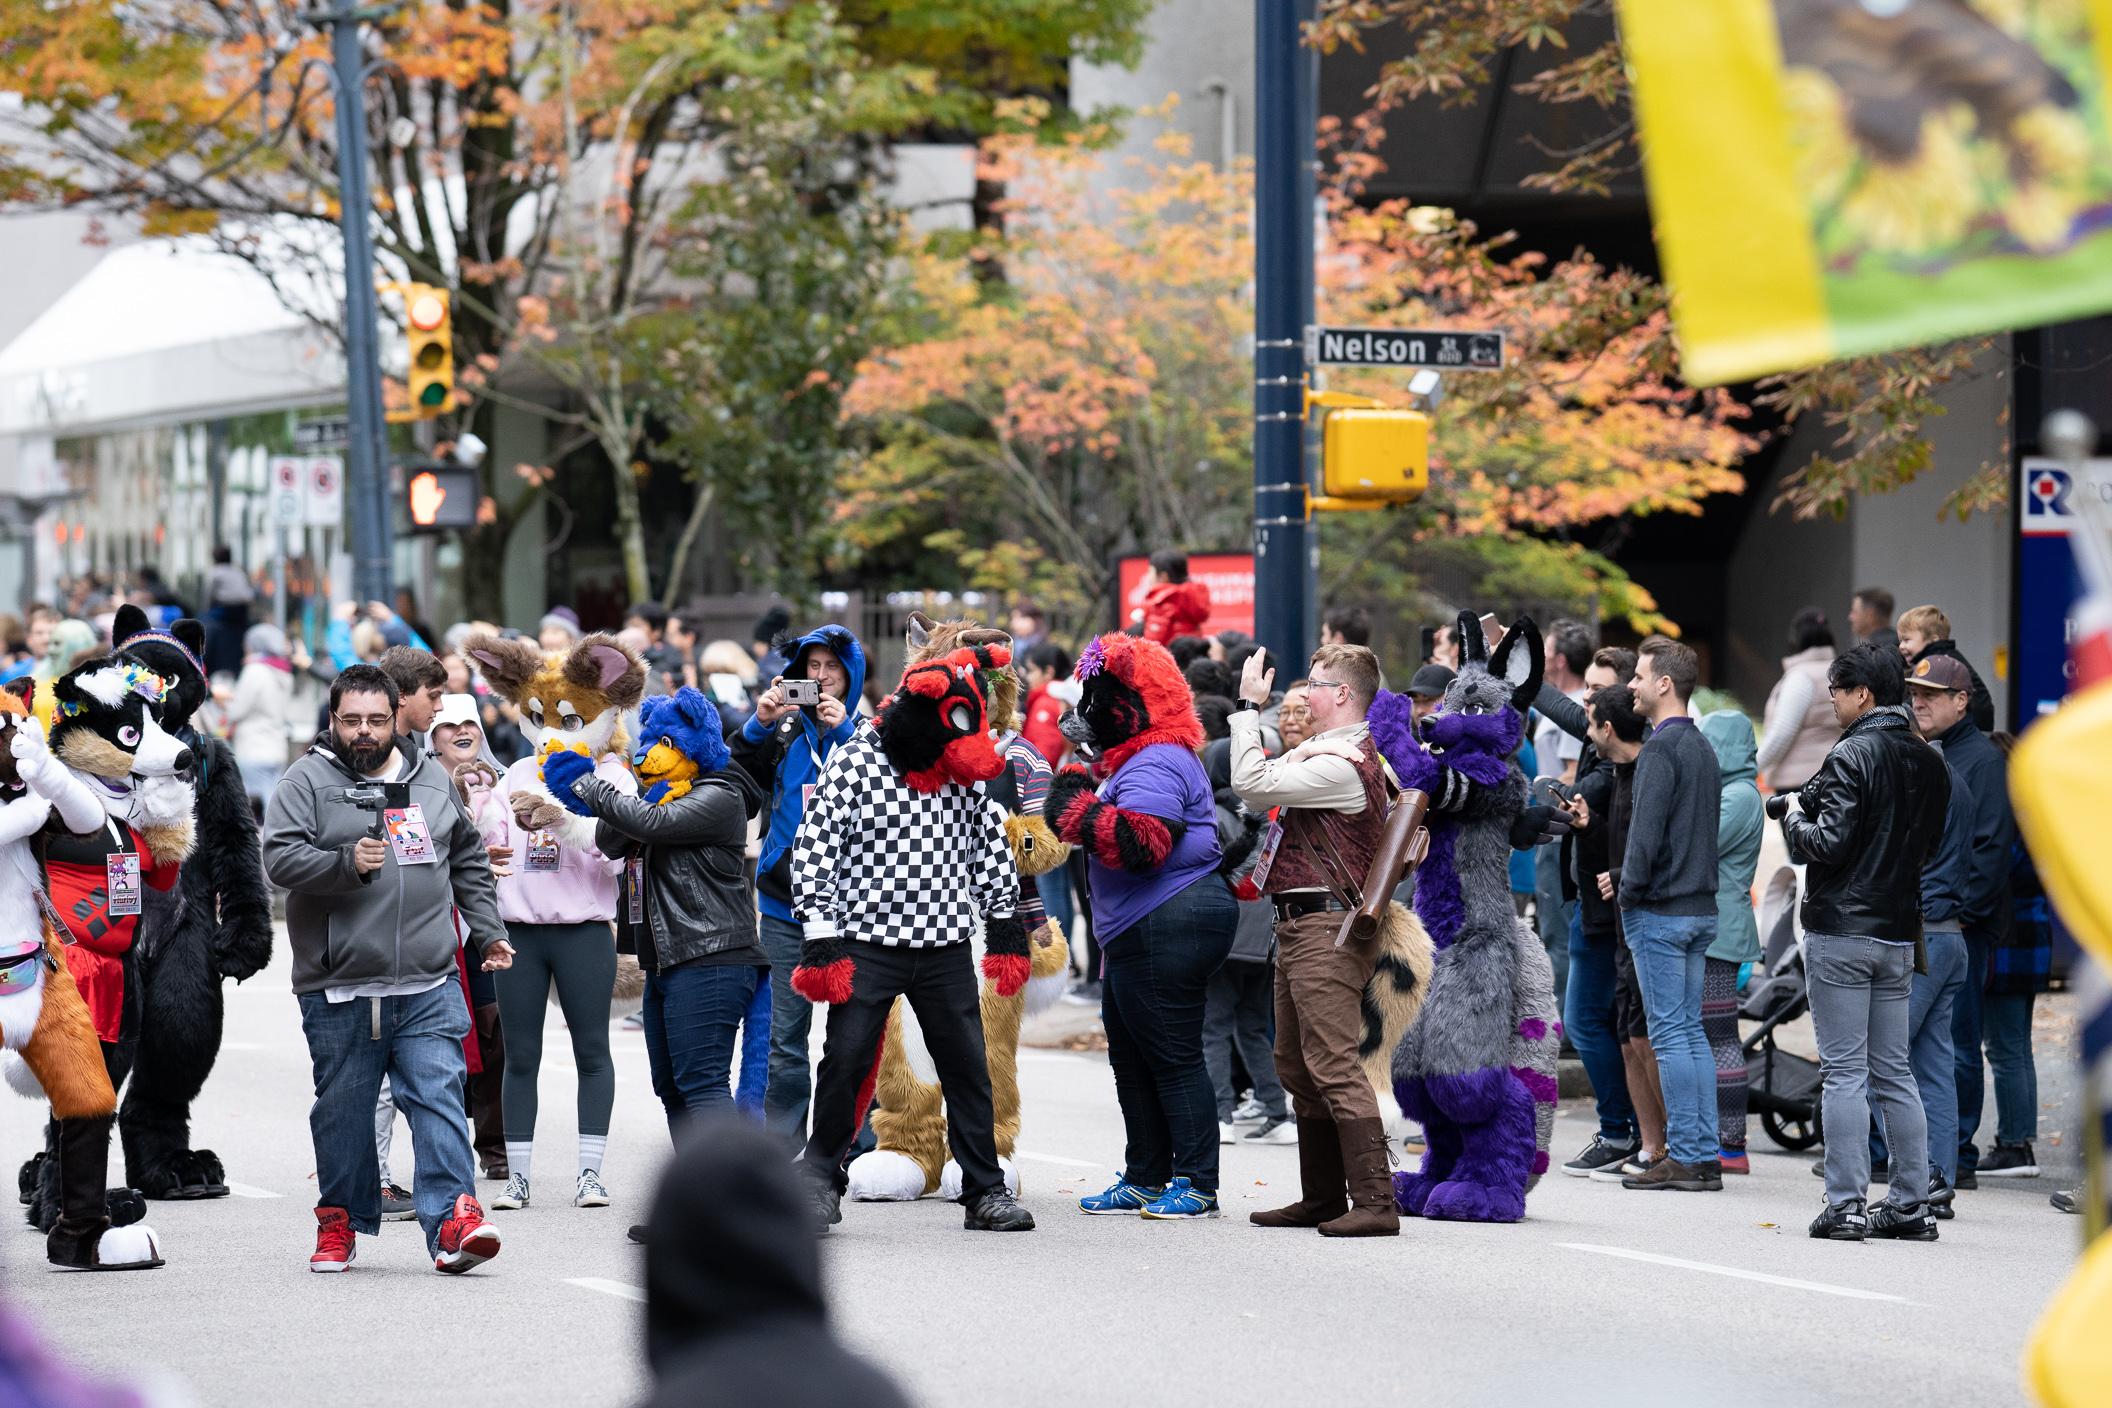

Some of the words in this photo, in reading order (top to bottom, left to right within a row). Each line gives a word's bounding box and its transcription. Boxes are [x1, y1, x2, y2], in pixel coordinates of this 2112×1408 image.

[1324, 333, 1426, 362] Nelson
[1440, 336, 1457, 351] St
[112, 894, 137, 905] Harley
[1845, 1214, 1866, 1226] PUMA
